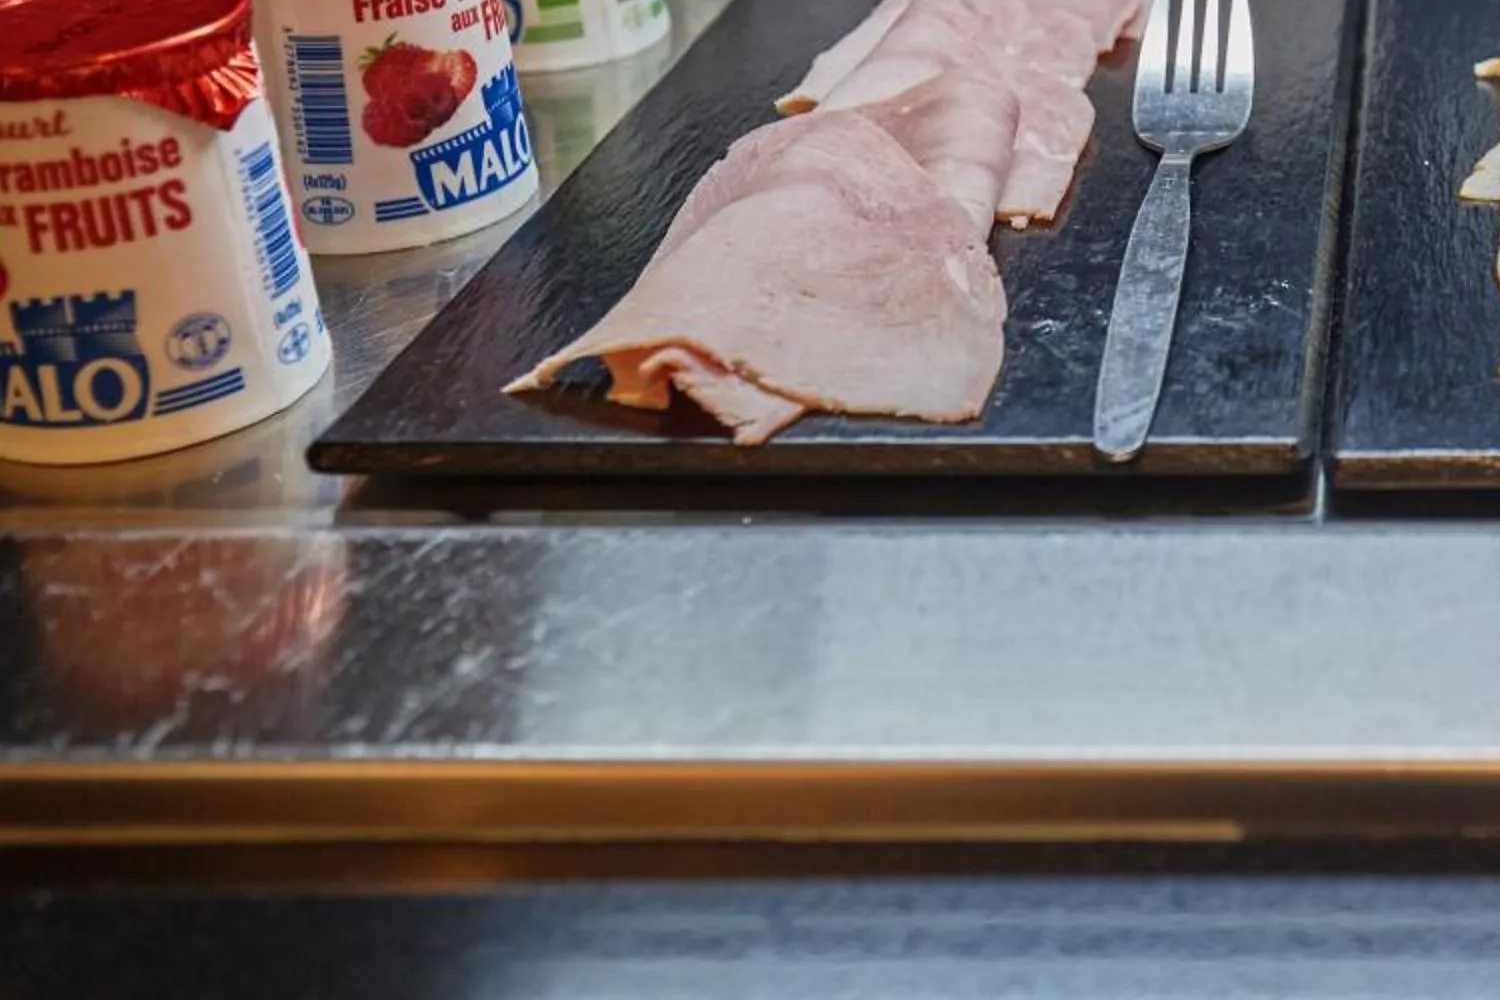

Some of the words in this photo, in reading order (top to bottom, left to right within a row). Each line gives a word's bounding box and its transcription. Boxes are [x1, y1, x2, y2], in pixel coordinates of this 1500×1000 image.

[450, 6, 480, 33] aux
[0, 136, 183, 194] ramboise
[428, 119, 533, 206] MALO
[24, 178, 193, 256] FRUITS
[3, 356, 143, 422] ALO
